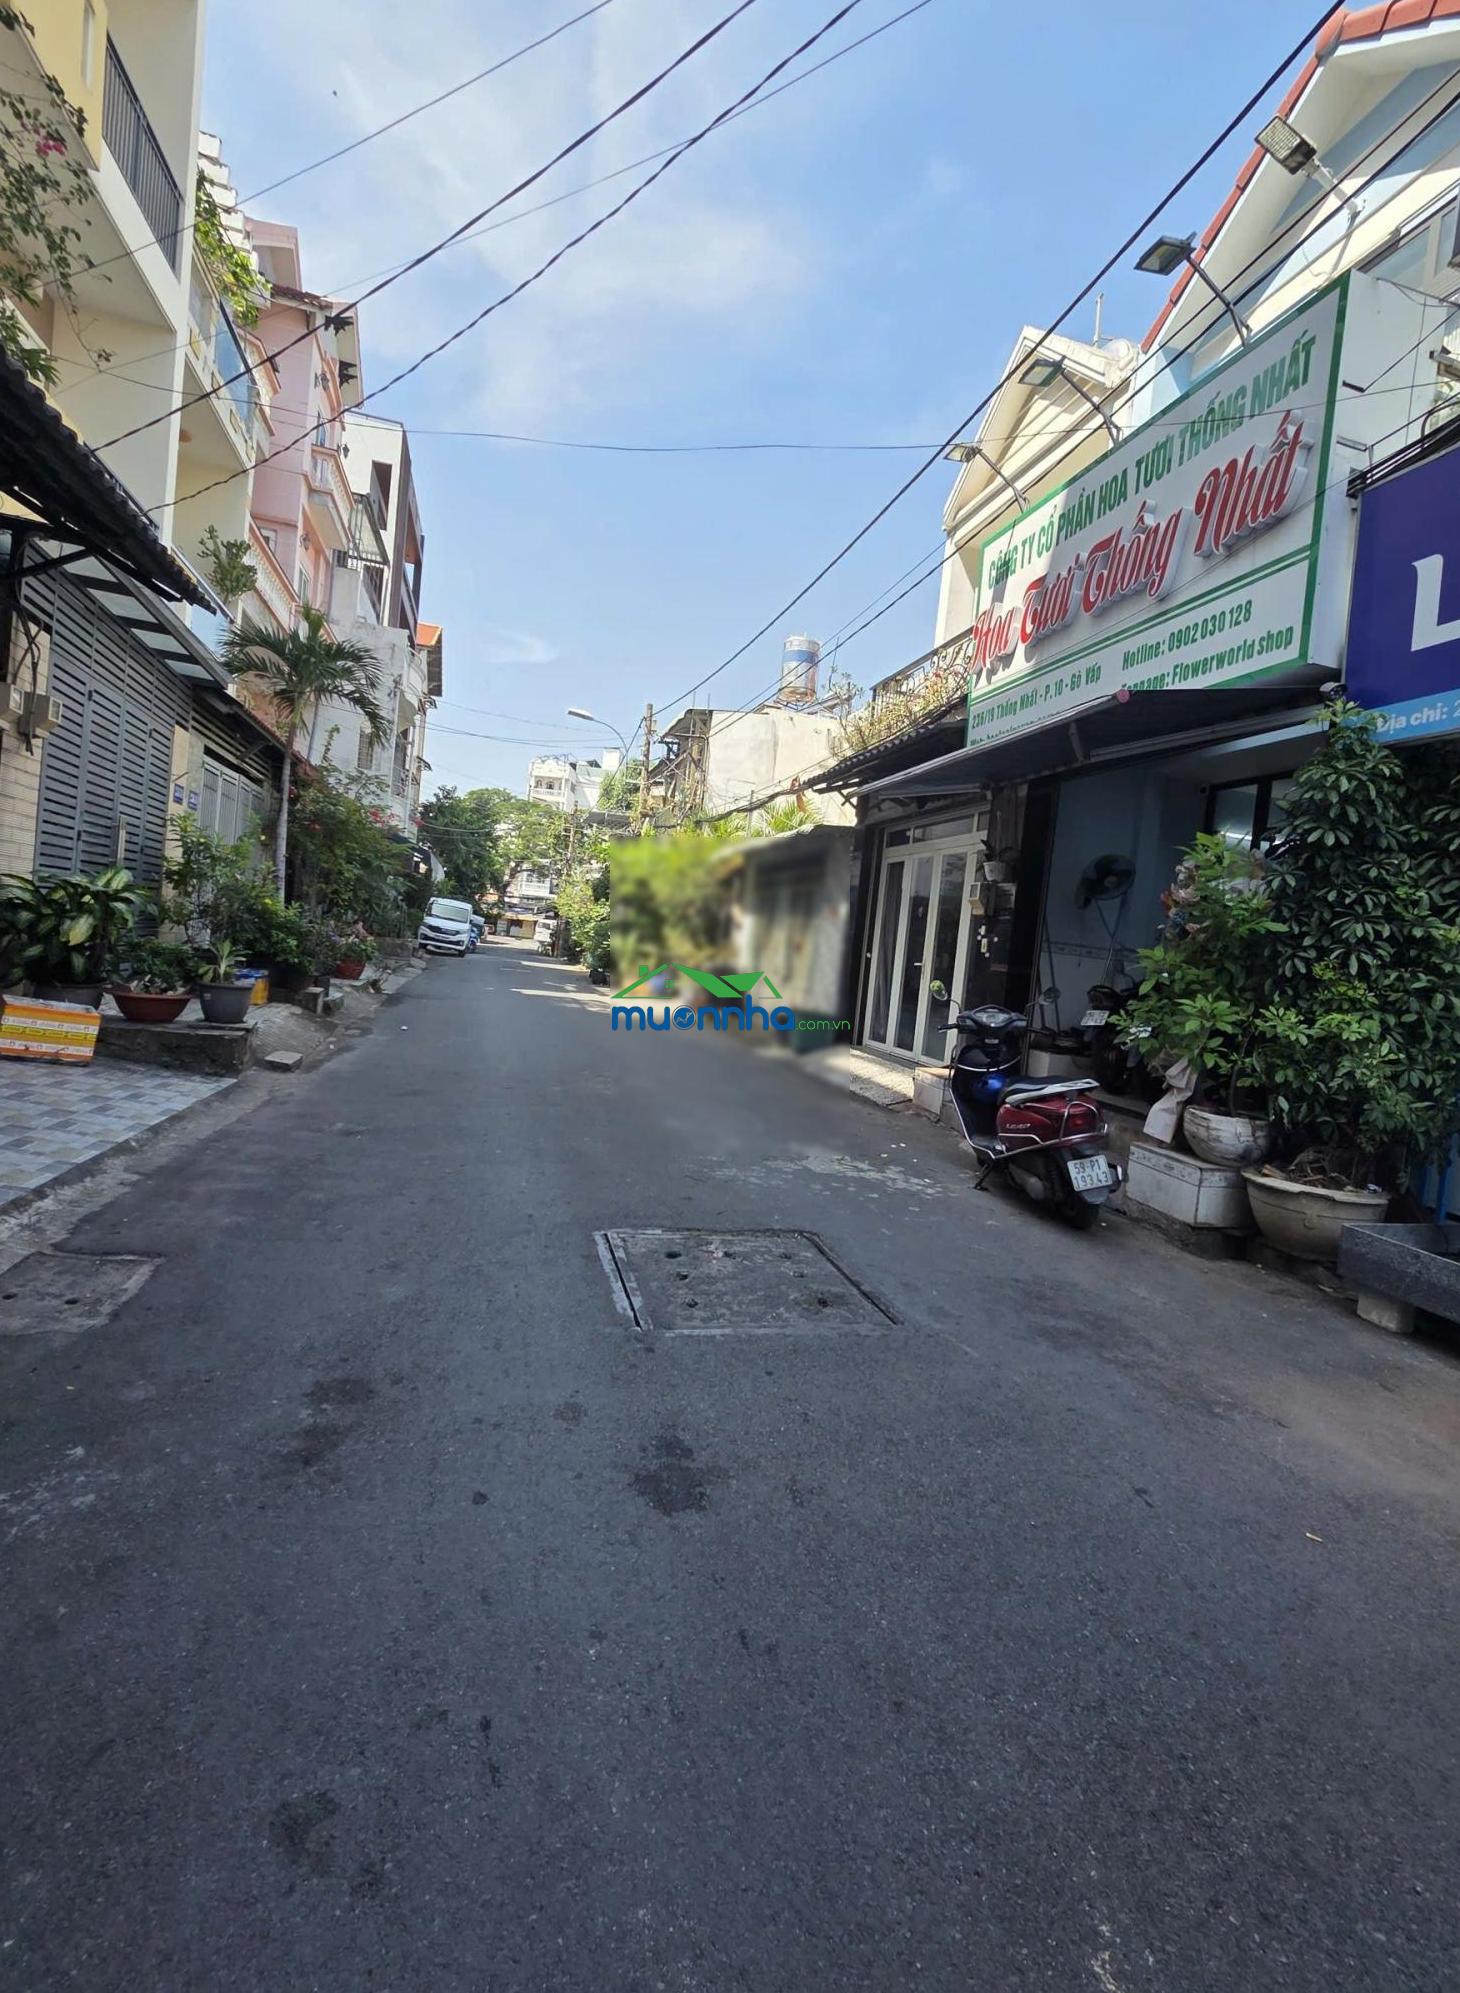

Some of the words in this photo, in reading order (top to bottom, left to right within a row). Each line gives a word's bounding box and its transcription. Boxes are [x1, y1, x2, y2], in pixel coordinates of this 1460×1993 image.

[988, 545, 1018, 591] CÔNG
[1021, 531, 1036, 570] TY
[1036, 504, 1057, 559] CỔ
[1056, 487, 1096, 547] PHẦN
[1097, 468, 1128, 519] HOA
[1135, 433, 1174, 495] TƯƠI
[1178, 391, 1248, 467] THỐNG
[1250, 329, 1317, 421] NHẤT
[970, 602, 1017, 670] Hoa
[1019, 552, 1080, 645] Tươi
[1081, 500, 1184, 615] Thống
[1194, 409, 1304, 554] Nhất
[1122, 639, 1166, 671] Hotline:
[1229, 599, 1253, 629] 128
[1171, 637, 1255, 686] Flowerworld
[1257, 625, 1295, 656] shop
[996, 697, 1018, 721] Thống
[1019, 687, 1038, 712] Nhất
[1070, 670, 1082, 692] Gò
[1085, 662, 1101, 686] Vấp
